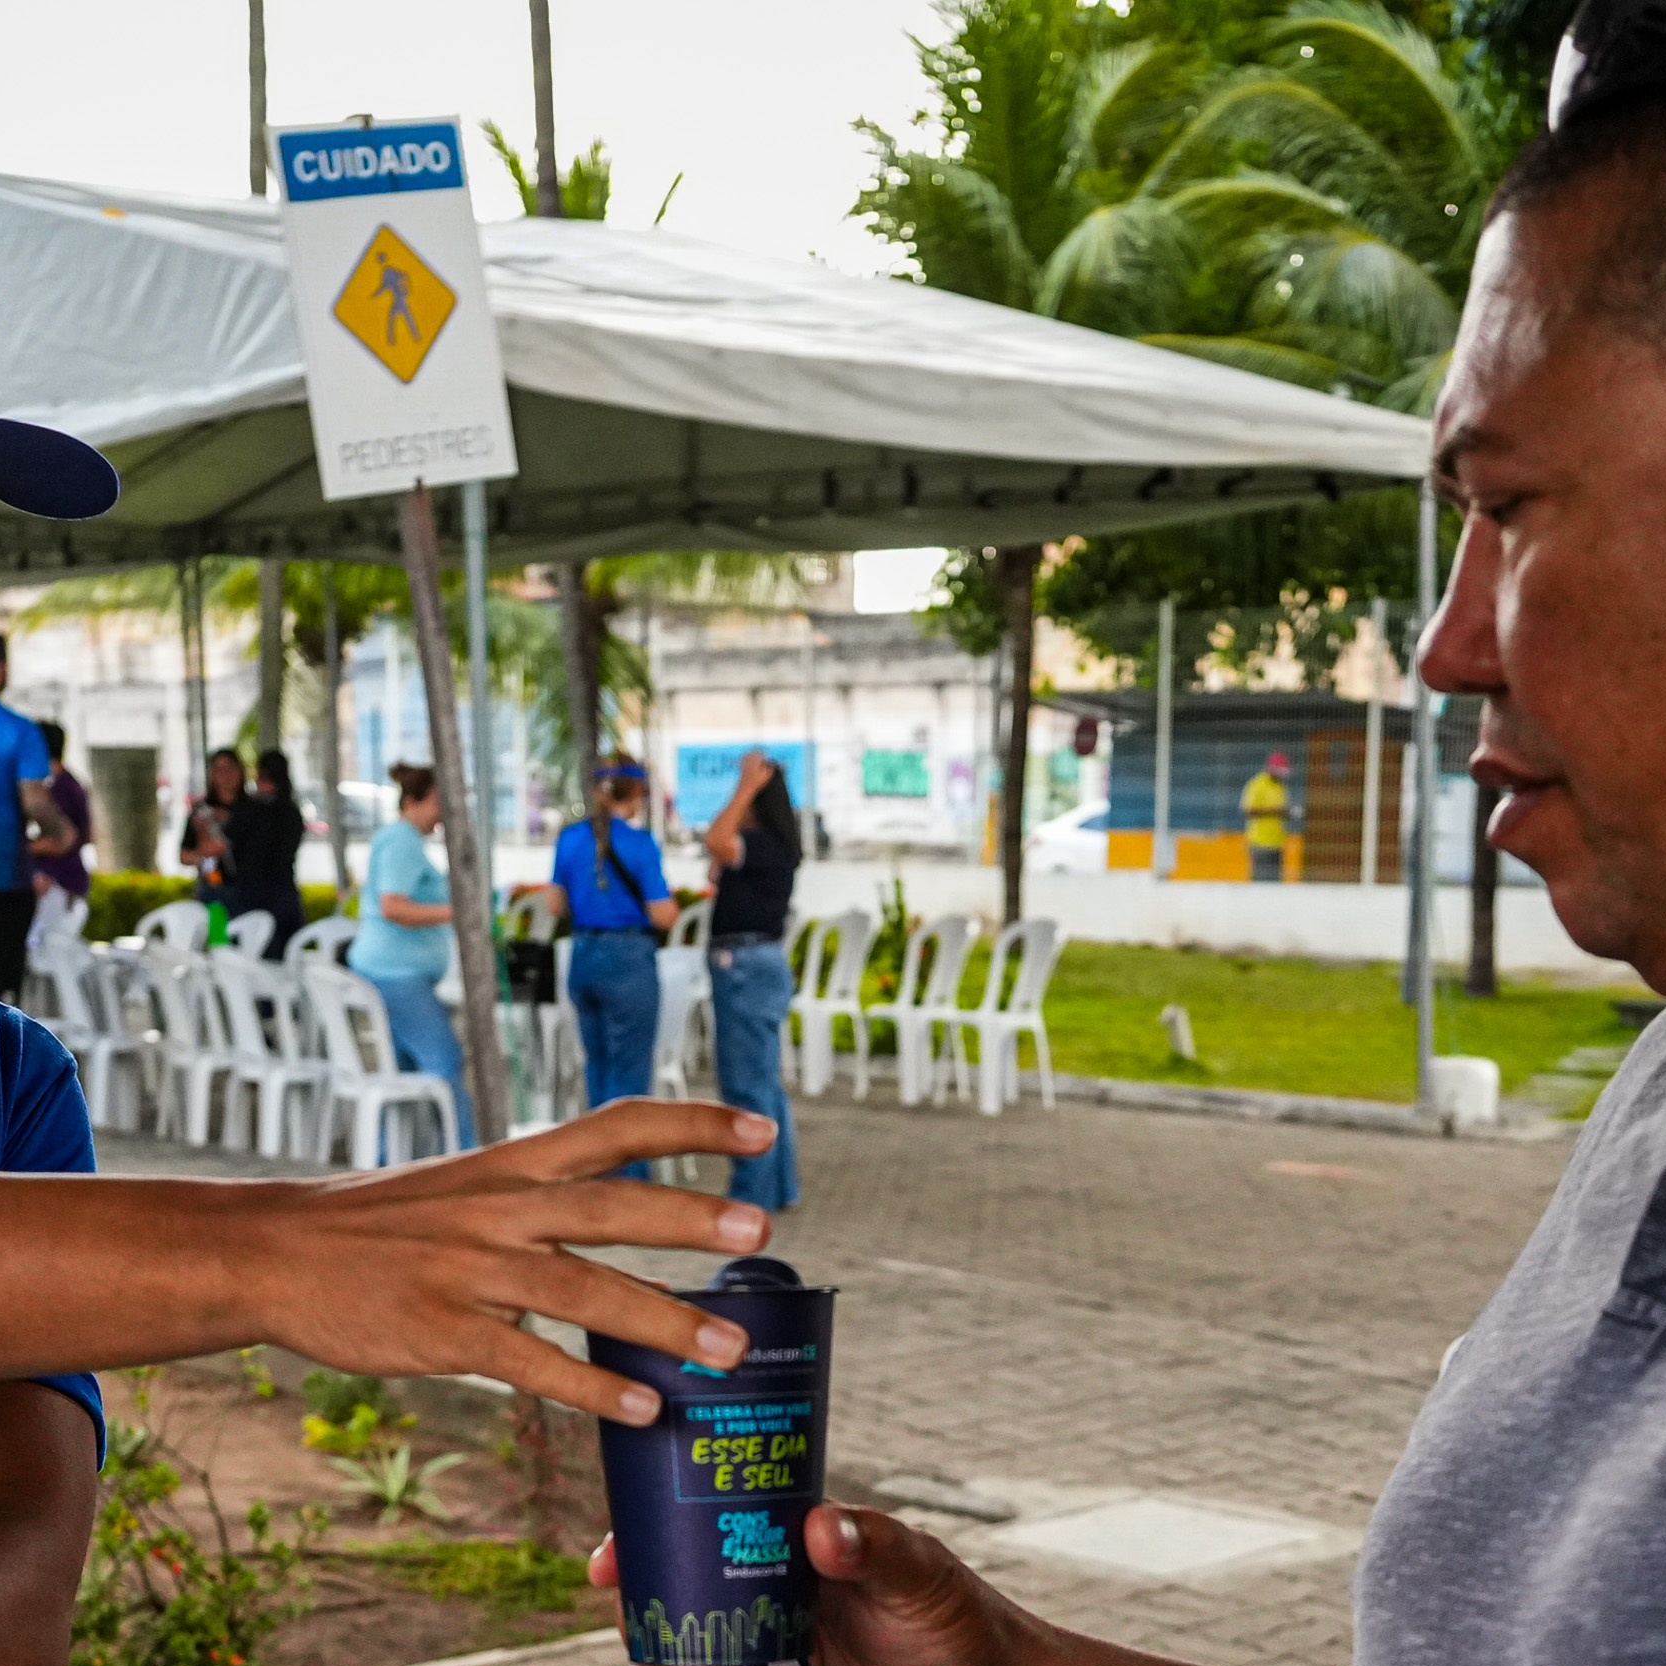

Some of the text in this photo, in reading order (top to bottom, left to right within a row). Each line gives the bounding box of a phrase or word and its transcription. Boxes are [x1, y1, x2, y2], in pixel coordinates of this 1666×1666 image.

[292, 141, 452, 183] CUIDADO
[337, 423, 496, 475] PEDESTRES
[691, 1432, 808, 1465] ESSE DIA
